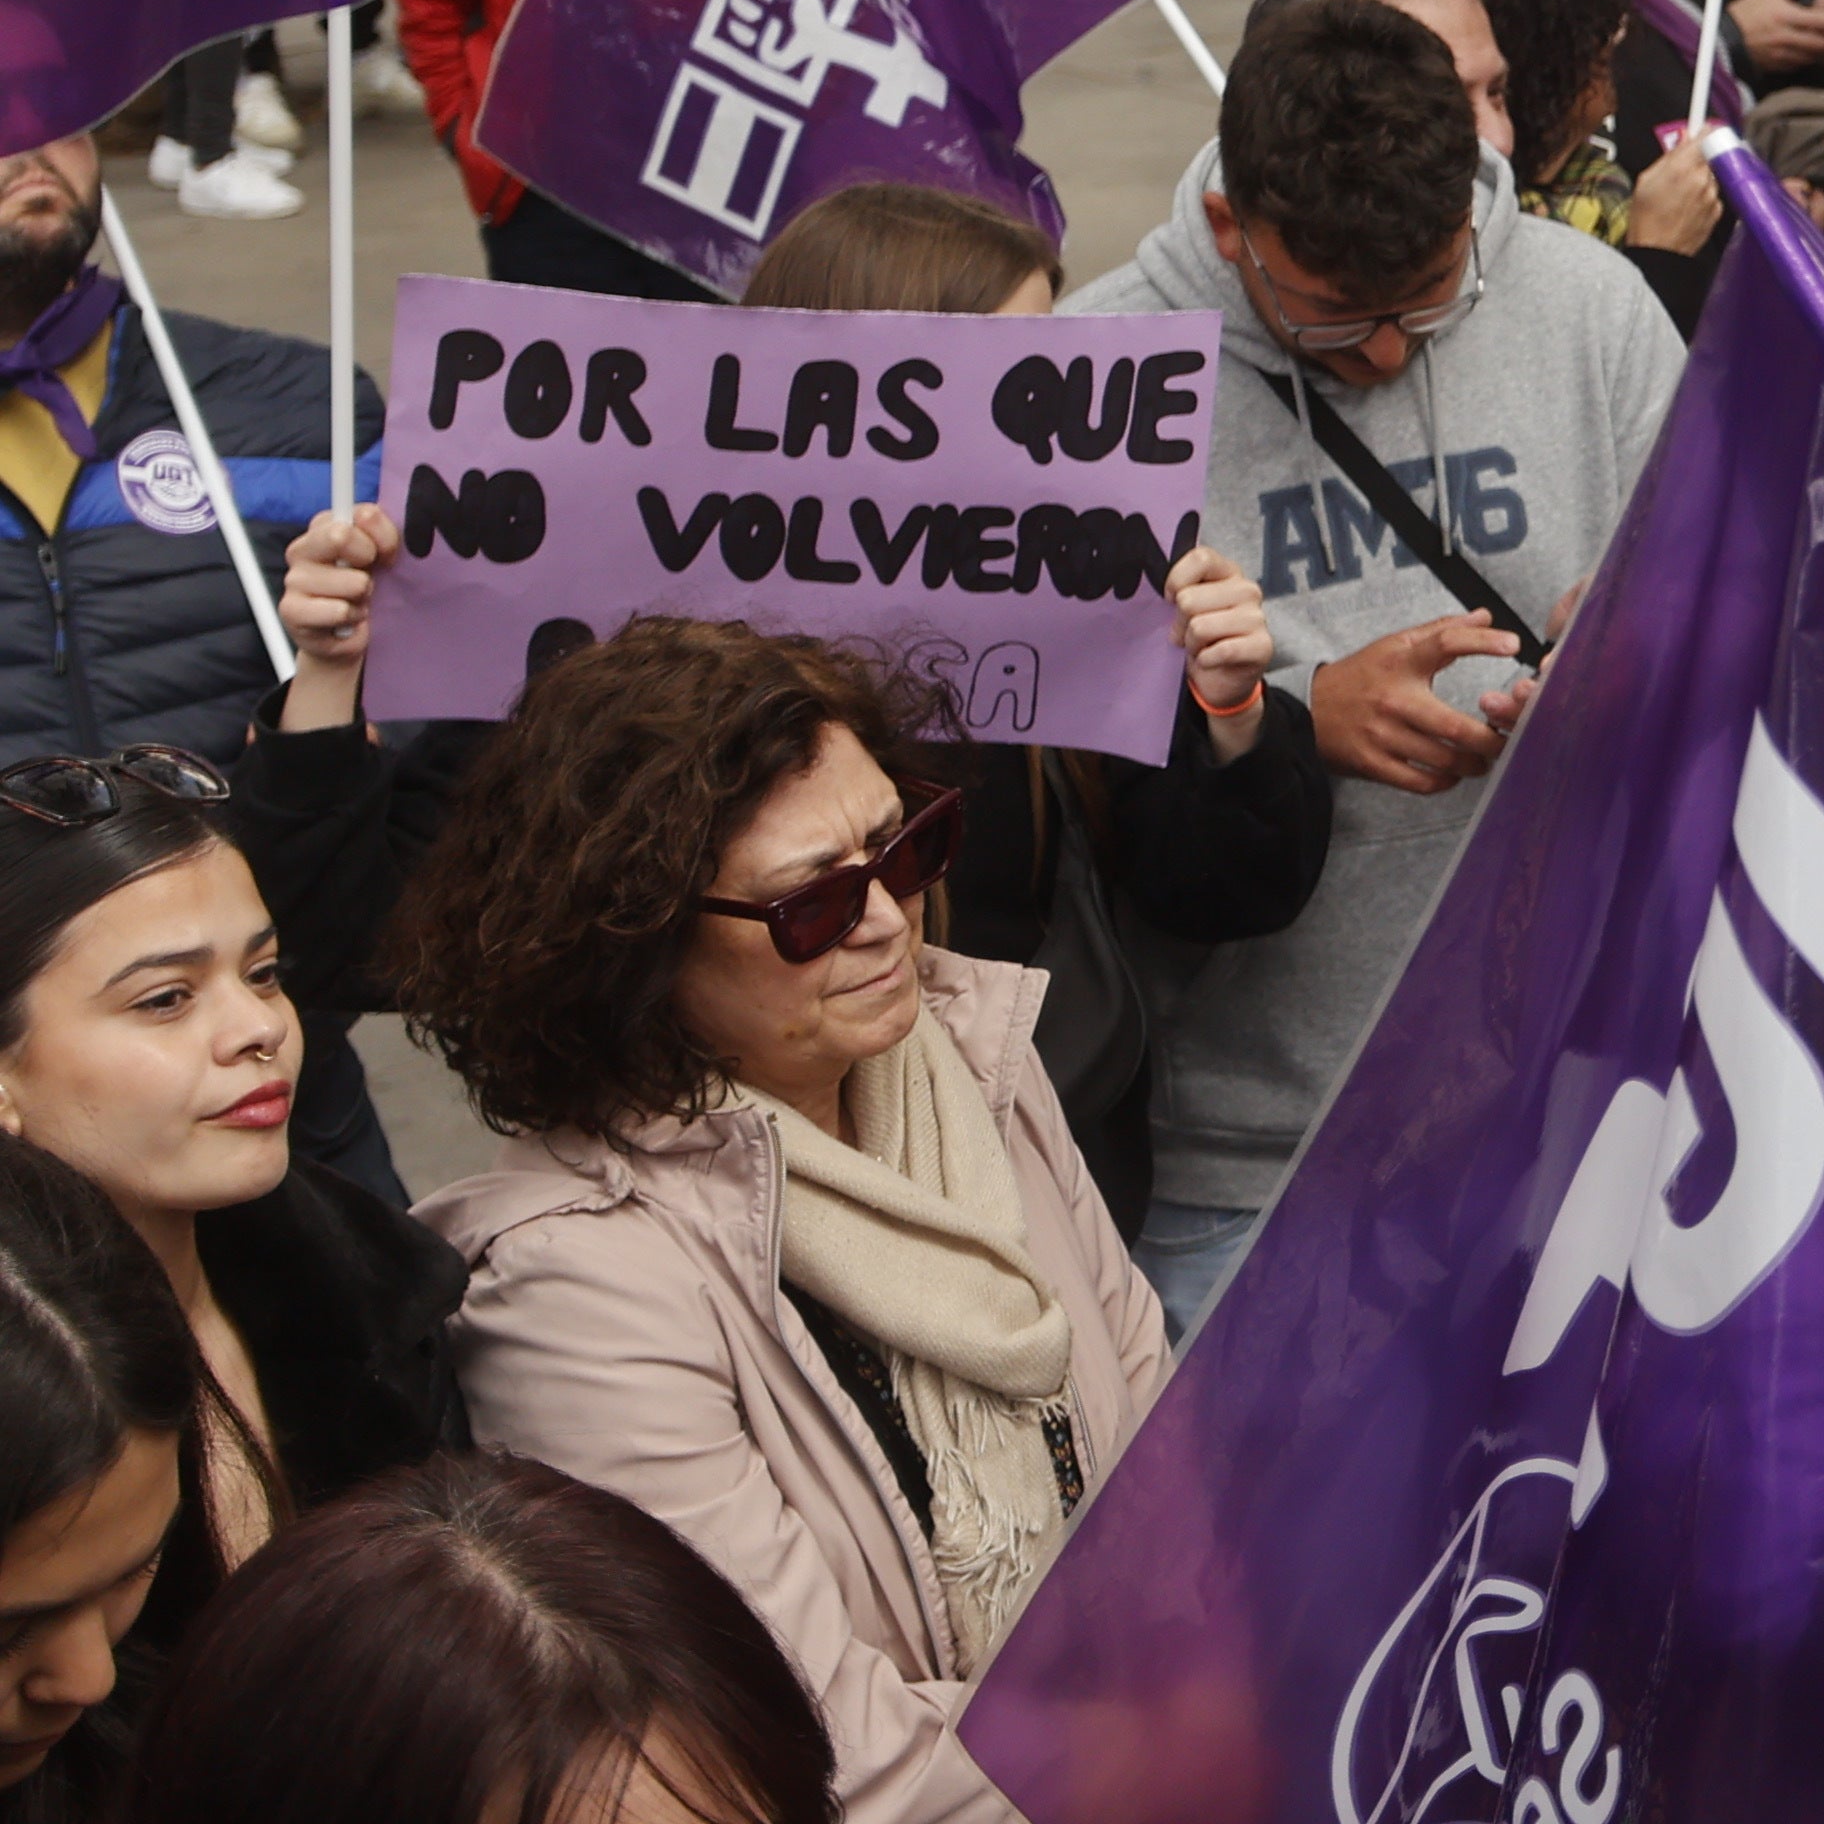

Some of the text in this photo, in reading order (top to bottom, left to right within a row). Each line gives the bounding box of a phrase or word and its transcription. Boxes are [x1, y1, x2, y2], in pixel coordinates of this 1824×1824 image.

[429, 328, 1206, 466] POR LAS QUE
[153, 464, 194, 488] UGT
[403, 463, 1199, 601] NO VOLVIERON
